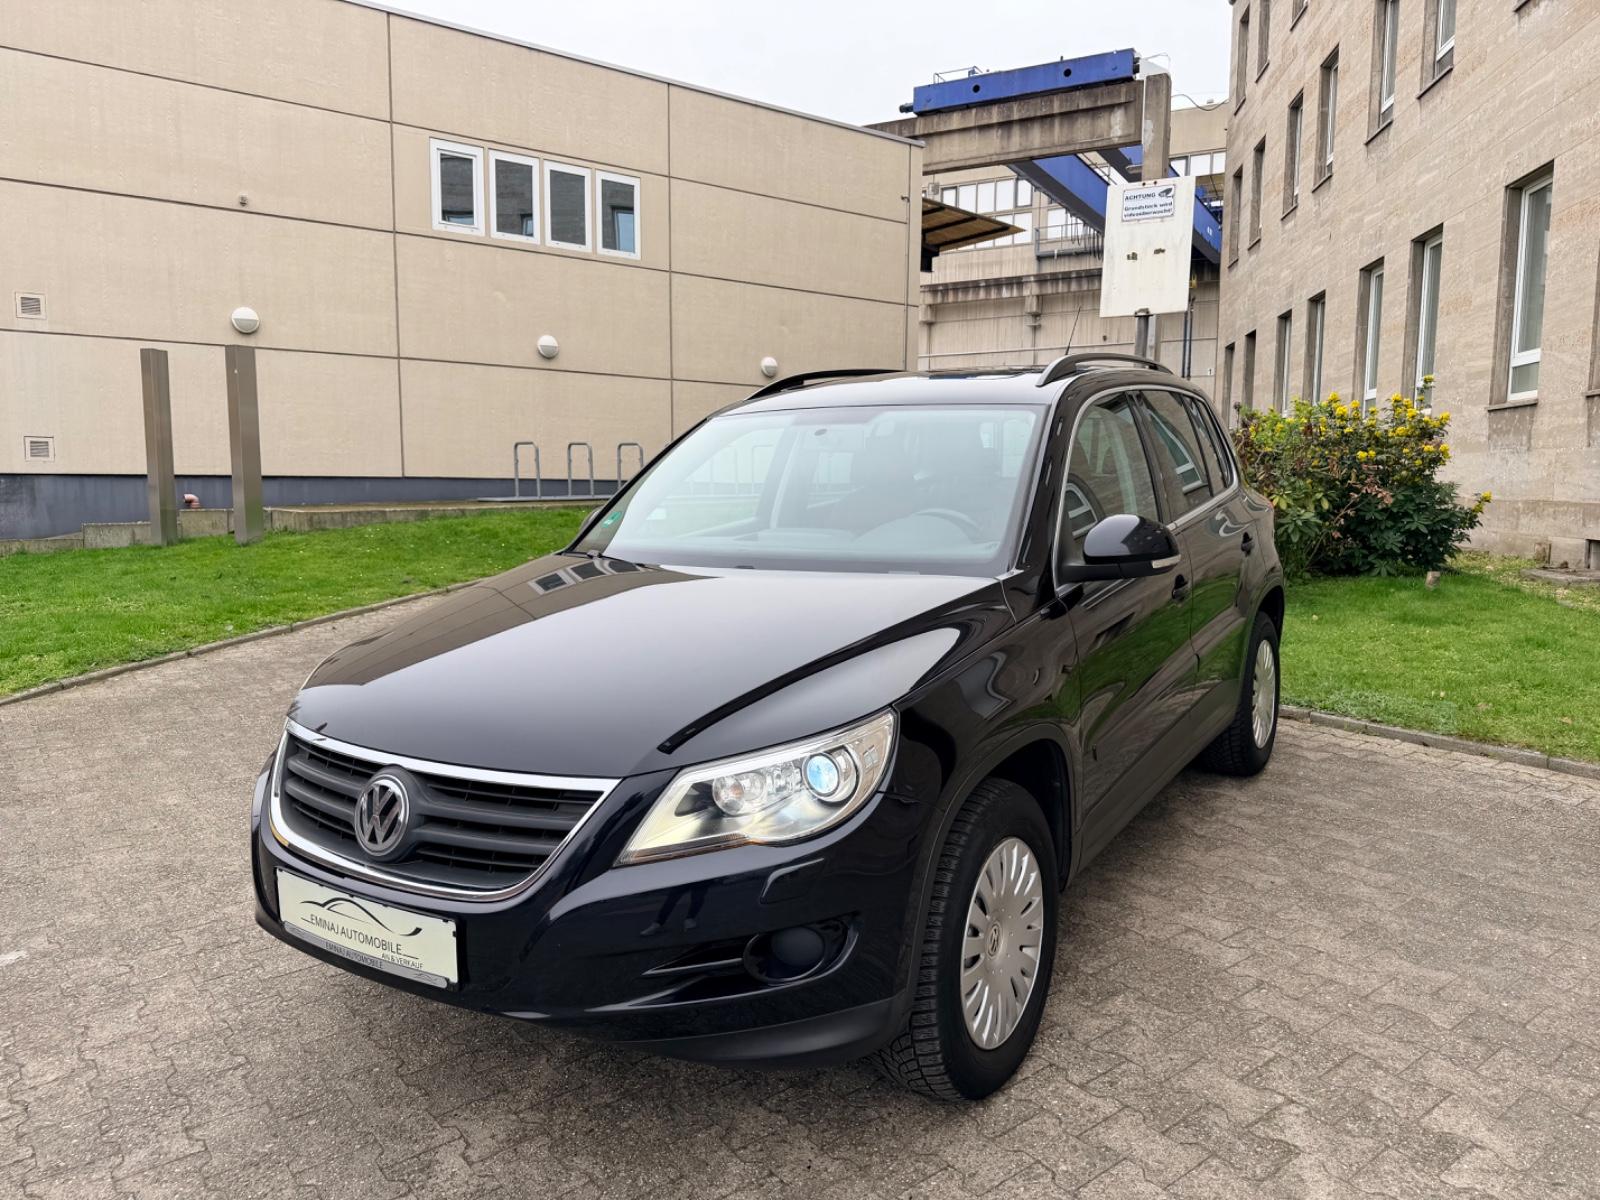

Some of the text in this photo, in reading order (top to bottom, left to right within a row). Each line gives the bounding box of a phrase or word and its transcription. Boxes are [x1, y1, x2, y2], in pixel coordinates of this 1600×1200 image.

[1125, 192, 1156, 201] ACHTUNG
[358, 779, 404, 849] VW
[310, 914, 402, 955] EMINAJ AUTOMOBILE
[396, 956, 424, 969] VERKAUF
